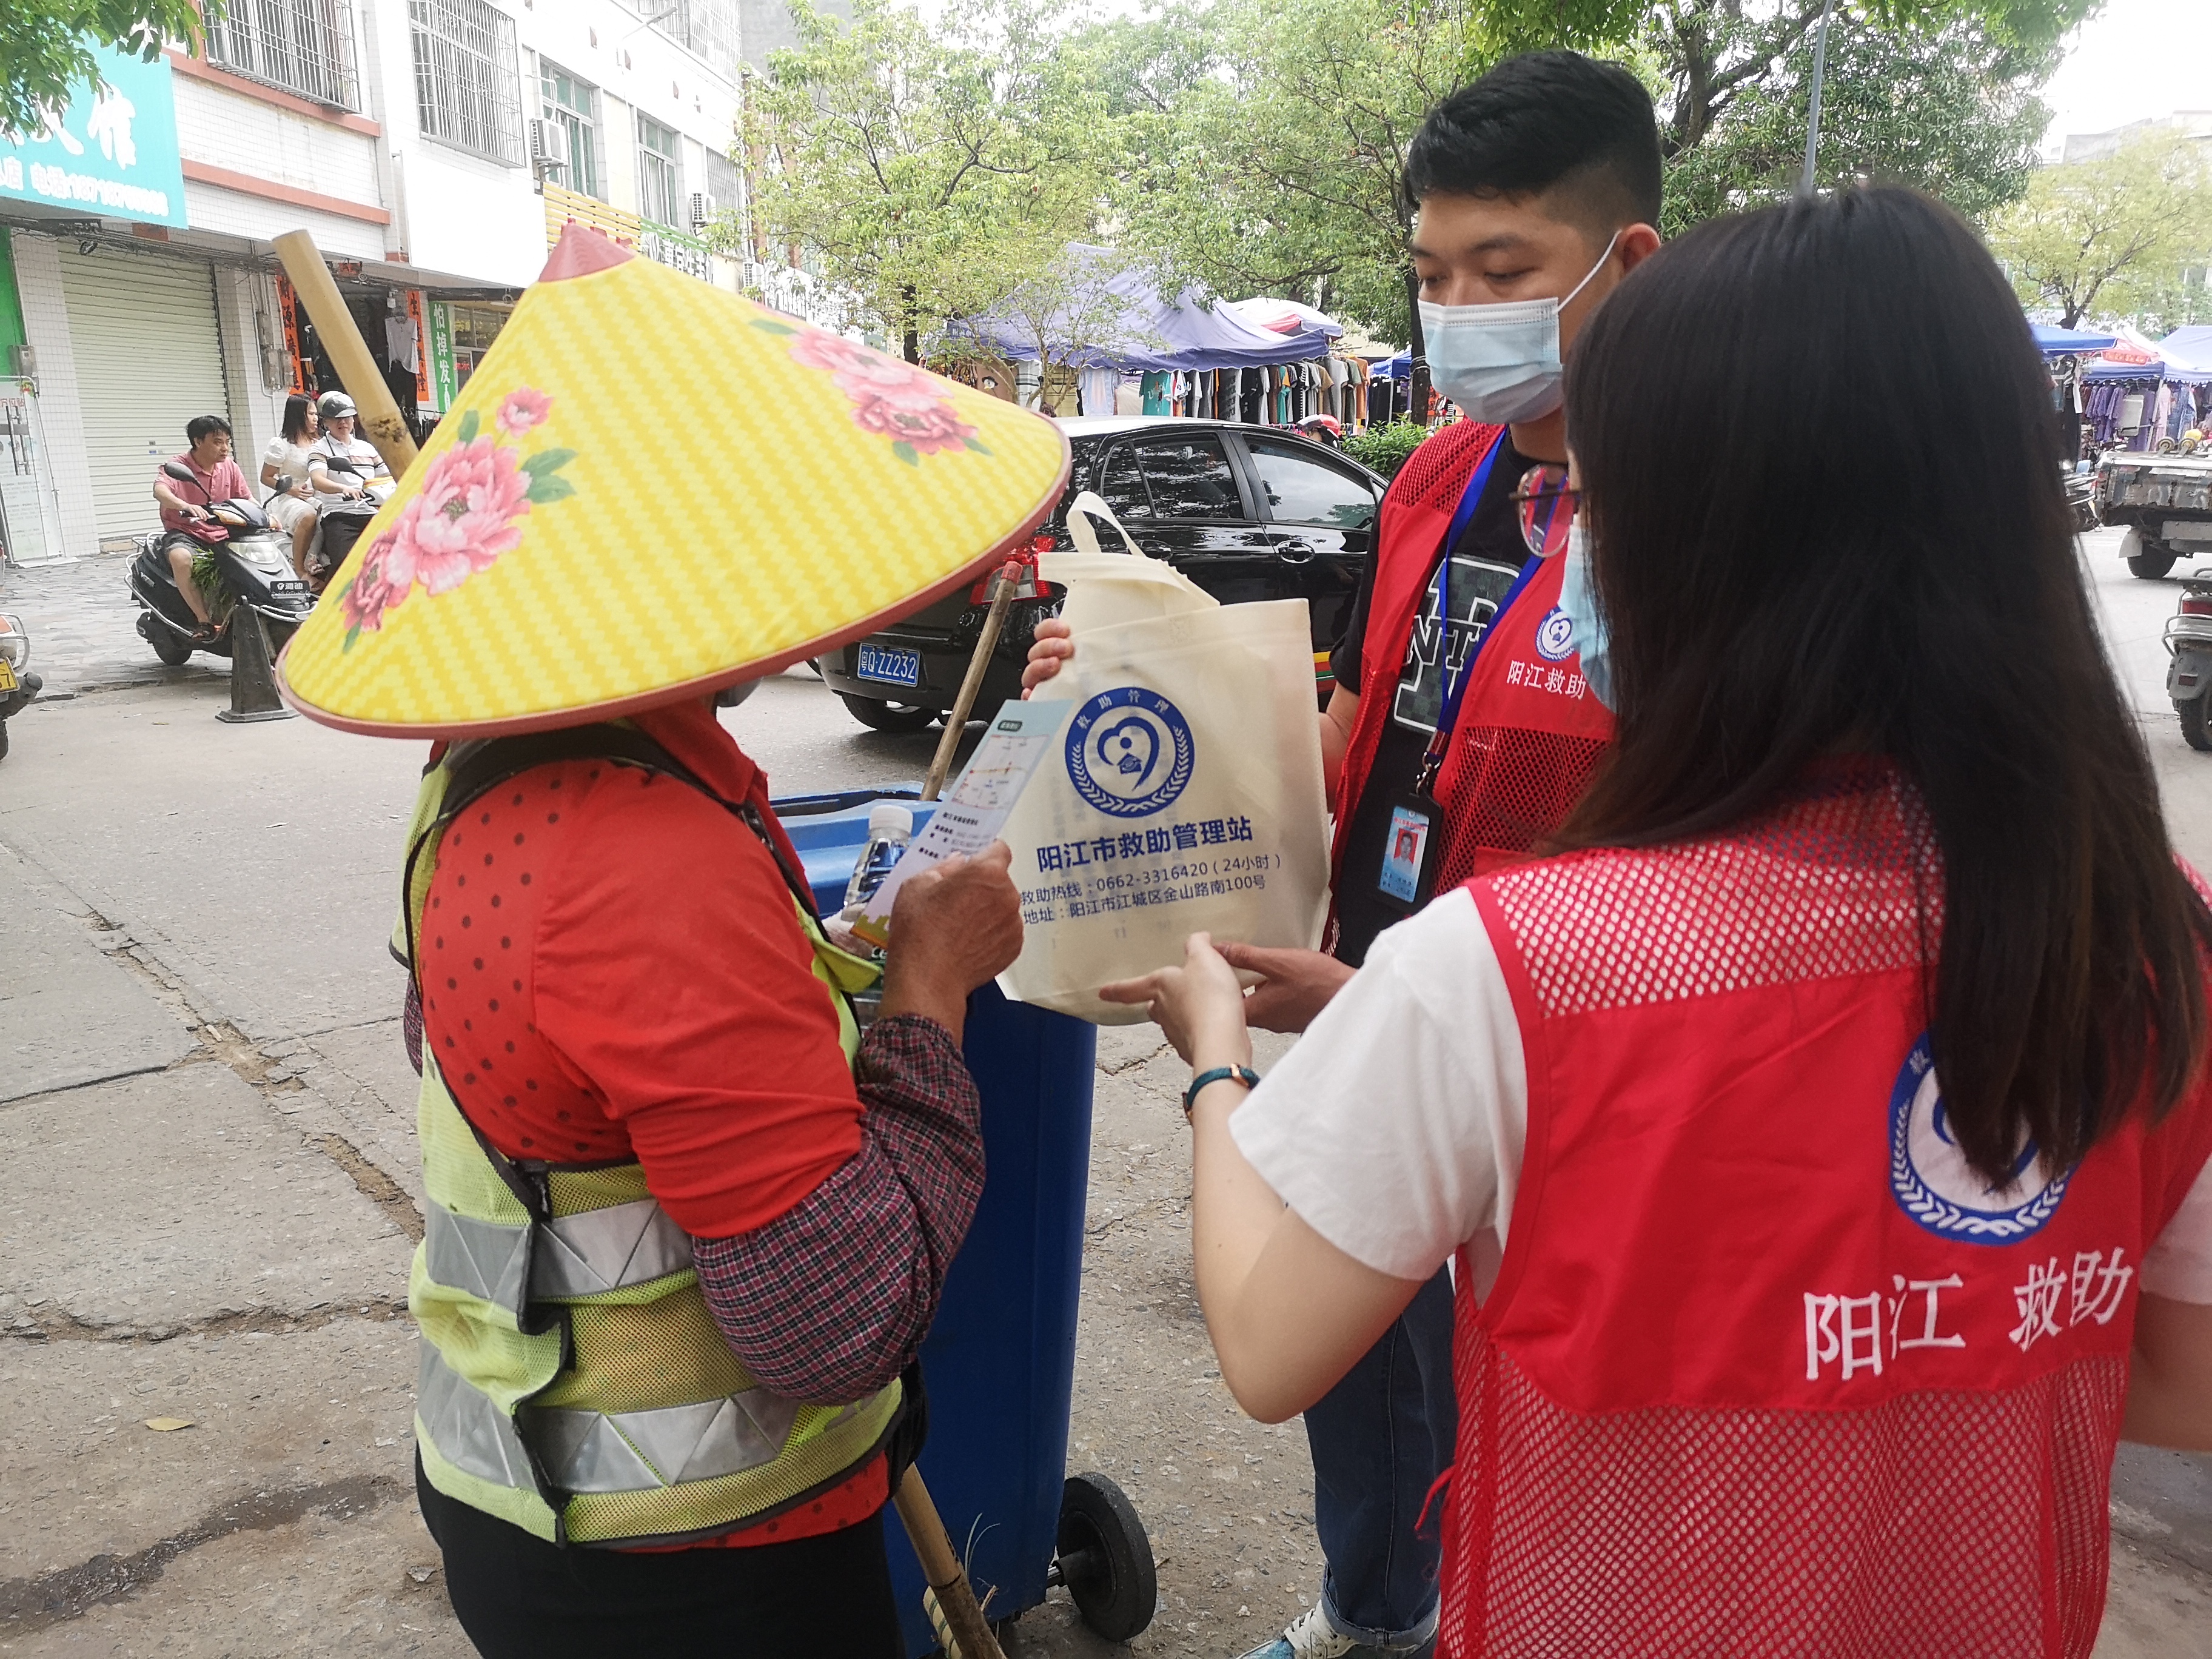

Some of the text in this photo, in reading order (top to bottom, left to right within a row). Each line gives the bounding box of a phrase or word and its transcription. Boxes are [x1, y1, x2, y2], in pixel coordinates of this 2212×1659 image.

[1506, 660, 1586, 699] 阳江救助
[1037, 815, 1254, 872] 阳江市救助管理站
[1803, 1247, 2134, 1381] 阳江 救助
